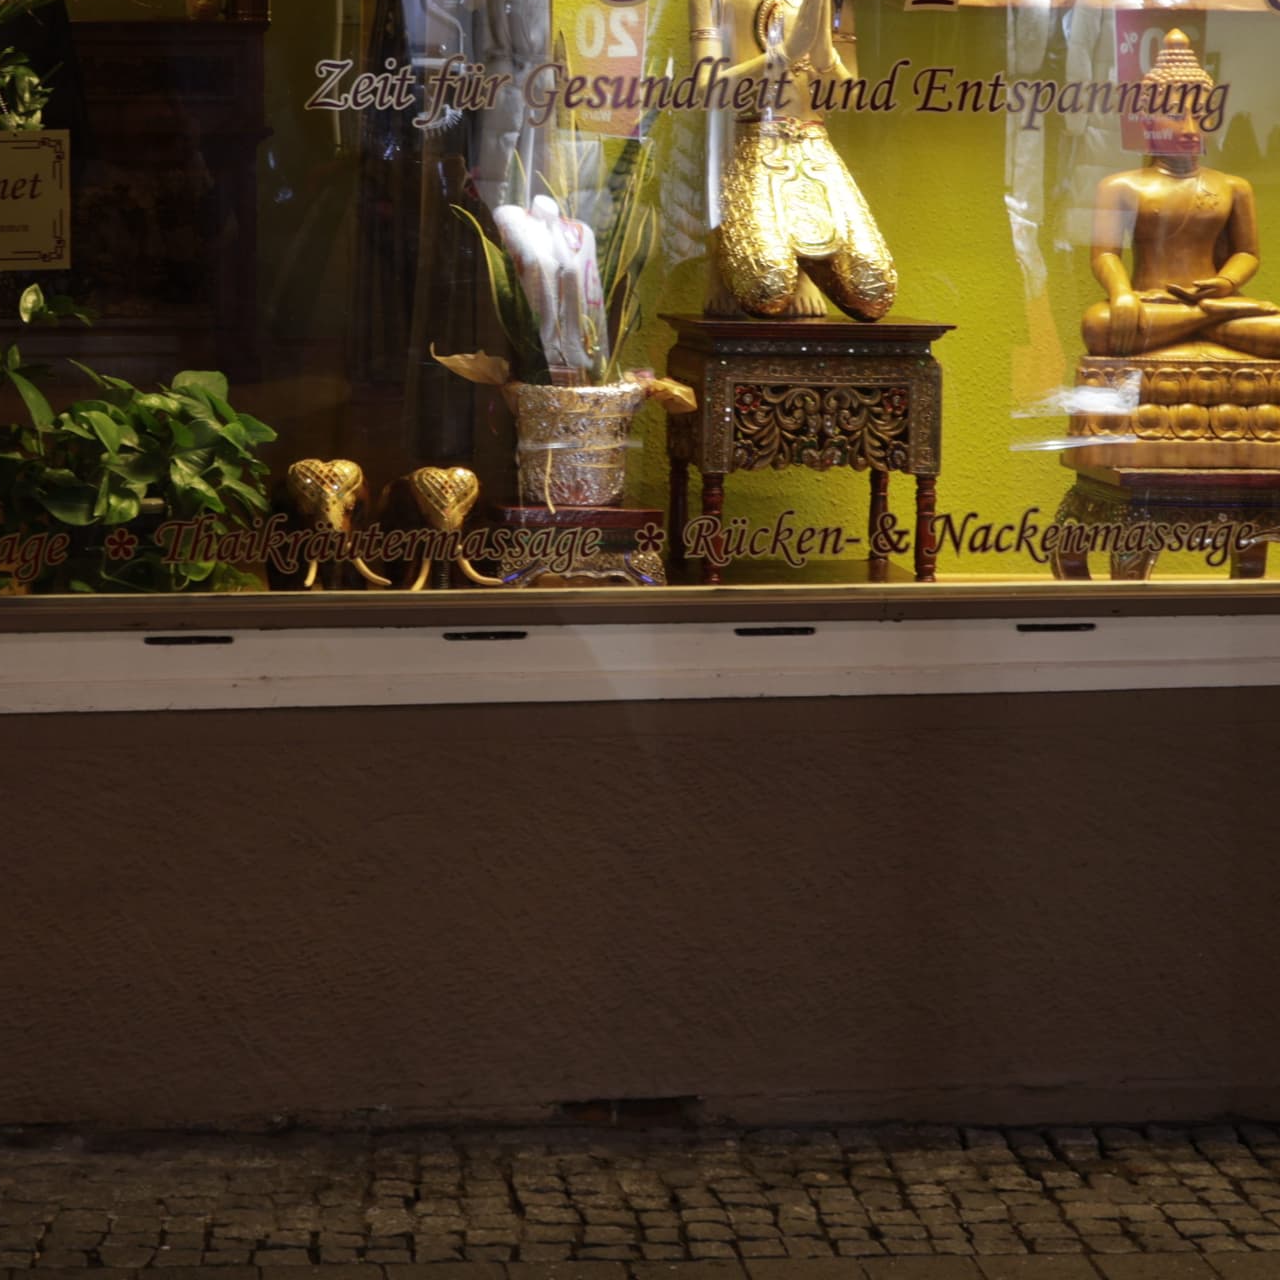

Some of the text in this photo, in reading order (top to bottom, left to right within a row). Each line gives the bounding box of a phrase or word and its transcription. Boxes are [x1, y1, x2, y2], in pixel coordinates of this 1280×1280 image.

[305, 53, 1232, 133] Zeit für Gesundheit und Entspannung
[153, 514, 604, 576] Thaikräutermassage
[683, 505, 1256, 566] Rücken- & Nackenmassage
